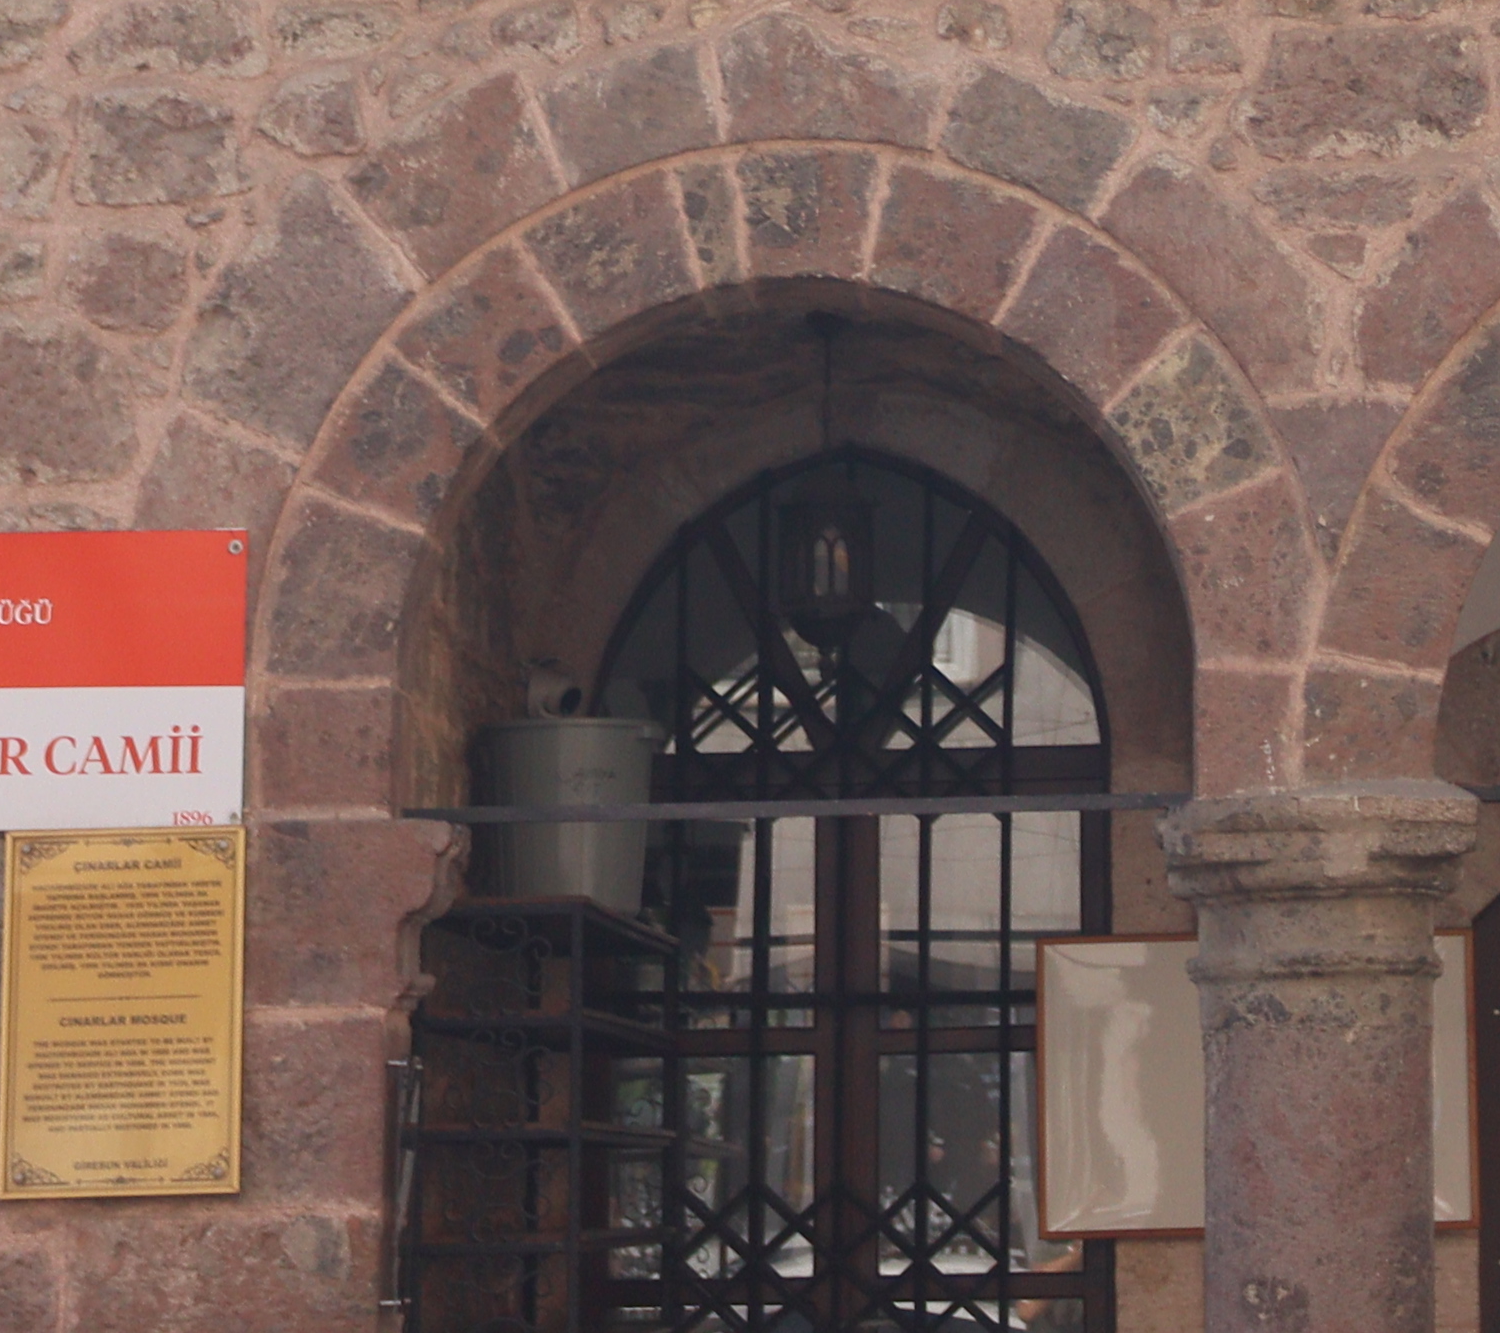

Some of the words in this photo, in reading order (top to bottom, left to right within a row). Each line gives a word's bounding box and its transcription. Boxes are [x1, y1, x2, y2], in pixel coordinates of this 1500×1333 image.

[43, 724, 204, 777] CAMİİ
[172, 810, 214, 826] 1896
[131, 1013, 187, 1024] MOSQUE
